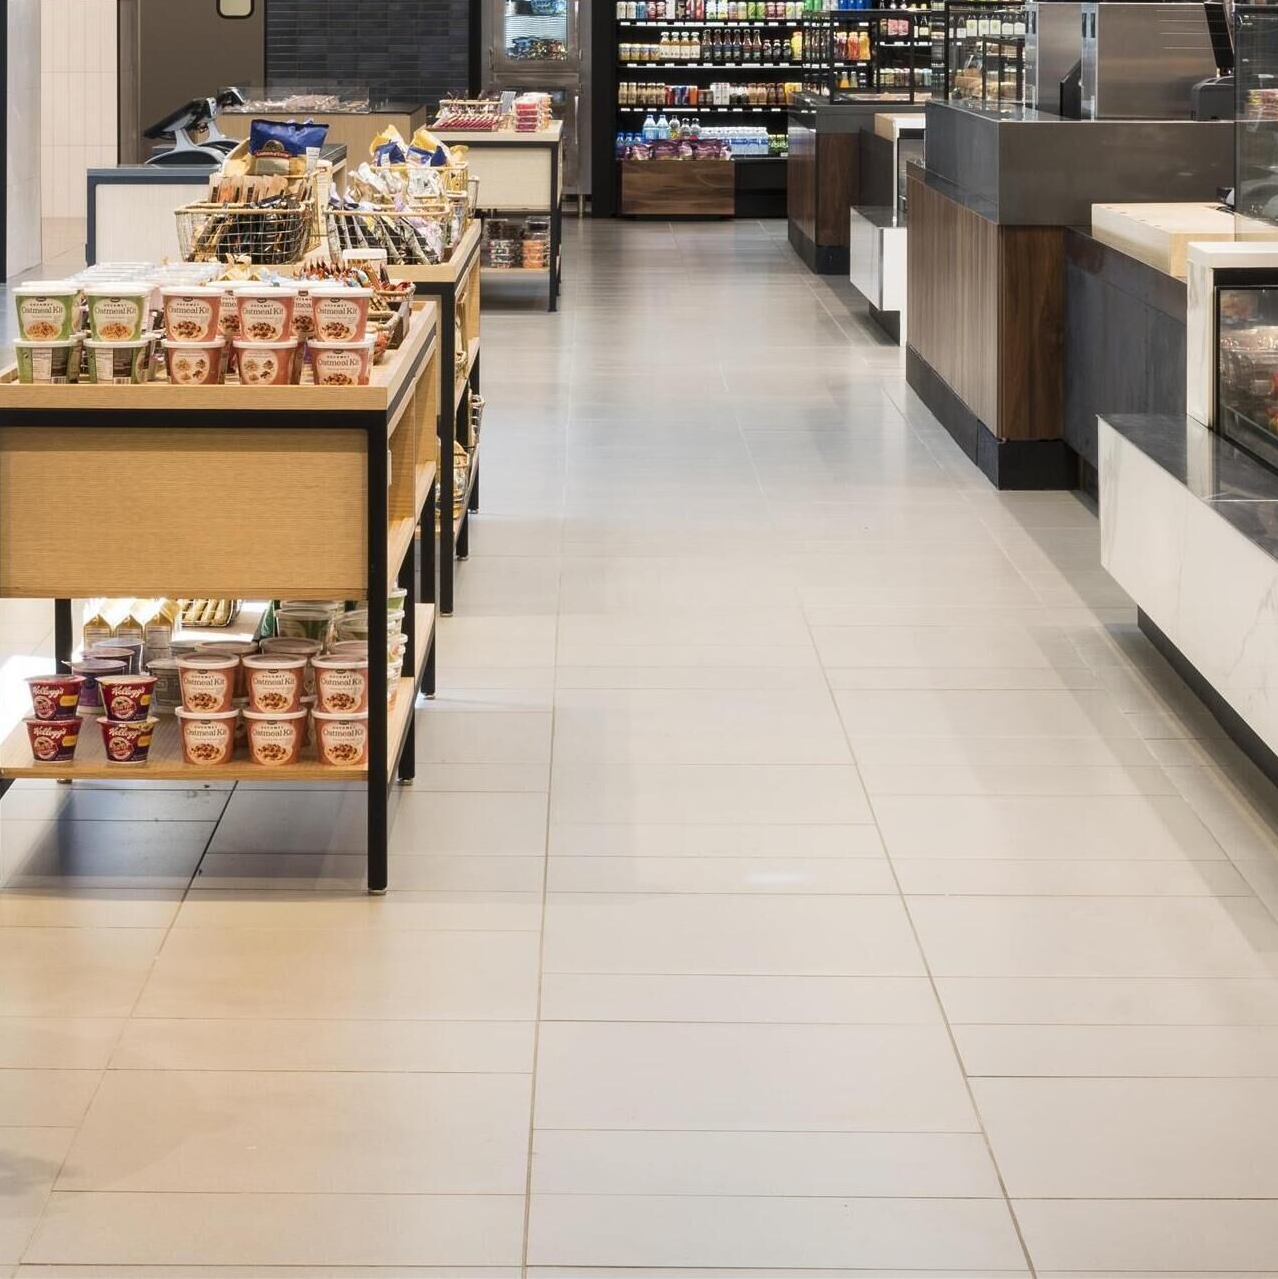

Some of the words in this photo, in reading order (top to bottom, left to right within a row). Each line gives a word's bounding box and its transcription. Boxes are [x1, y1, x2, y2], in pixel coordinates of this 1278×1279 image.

[22, 306, 52, 314] Oatmeal
[51, 306, 63, 314] Kit
[95, 307, 125, 315] Oatmeal
[125, 307, 137, 315] Kit
[168, 306, 198, 314] Oatmeal
[198, 306, 210, 314] Kit
[242, 307, 273, 315] Oatmeal
[273, 307, 283, 315] Kit
[316, 307, 347, 315] Oatmeal
[346, 307, 358, 315] Kit
[318, 359, 348, 367] Oatmeal
[348, 359, 359, 367] Kit
[183, 678, 214, 686] Oatmeal
[214, 678, 225, 686] Kit
[253, 677, 284, 685] Oatmeal
[284, 677, 295, 685] Kit
[320, 677, 352, 686] Oatmeal
[351, 677, 362, 686] Kit
[32, 685, 64, 698] Kellogg's
[112, 685, 145, 698] Kellogg's
[33, 726, 67, 739] Kellogg's
[108, 727, 142, 739] Kellogg's
[186, 728, 216, 736] Oatmeal
[216, 728, 227, 736] Kit
[252, 728, 283, 736] Oatmeal
[283, 728, 294, 736] Kit
[322, 728, 354, 736] Oatmeal
[353, 728, 364, 736] Kit
